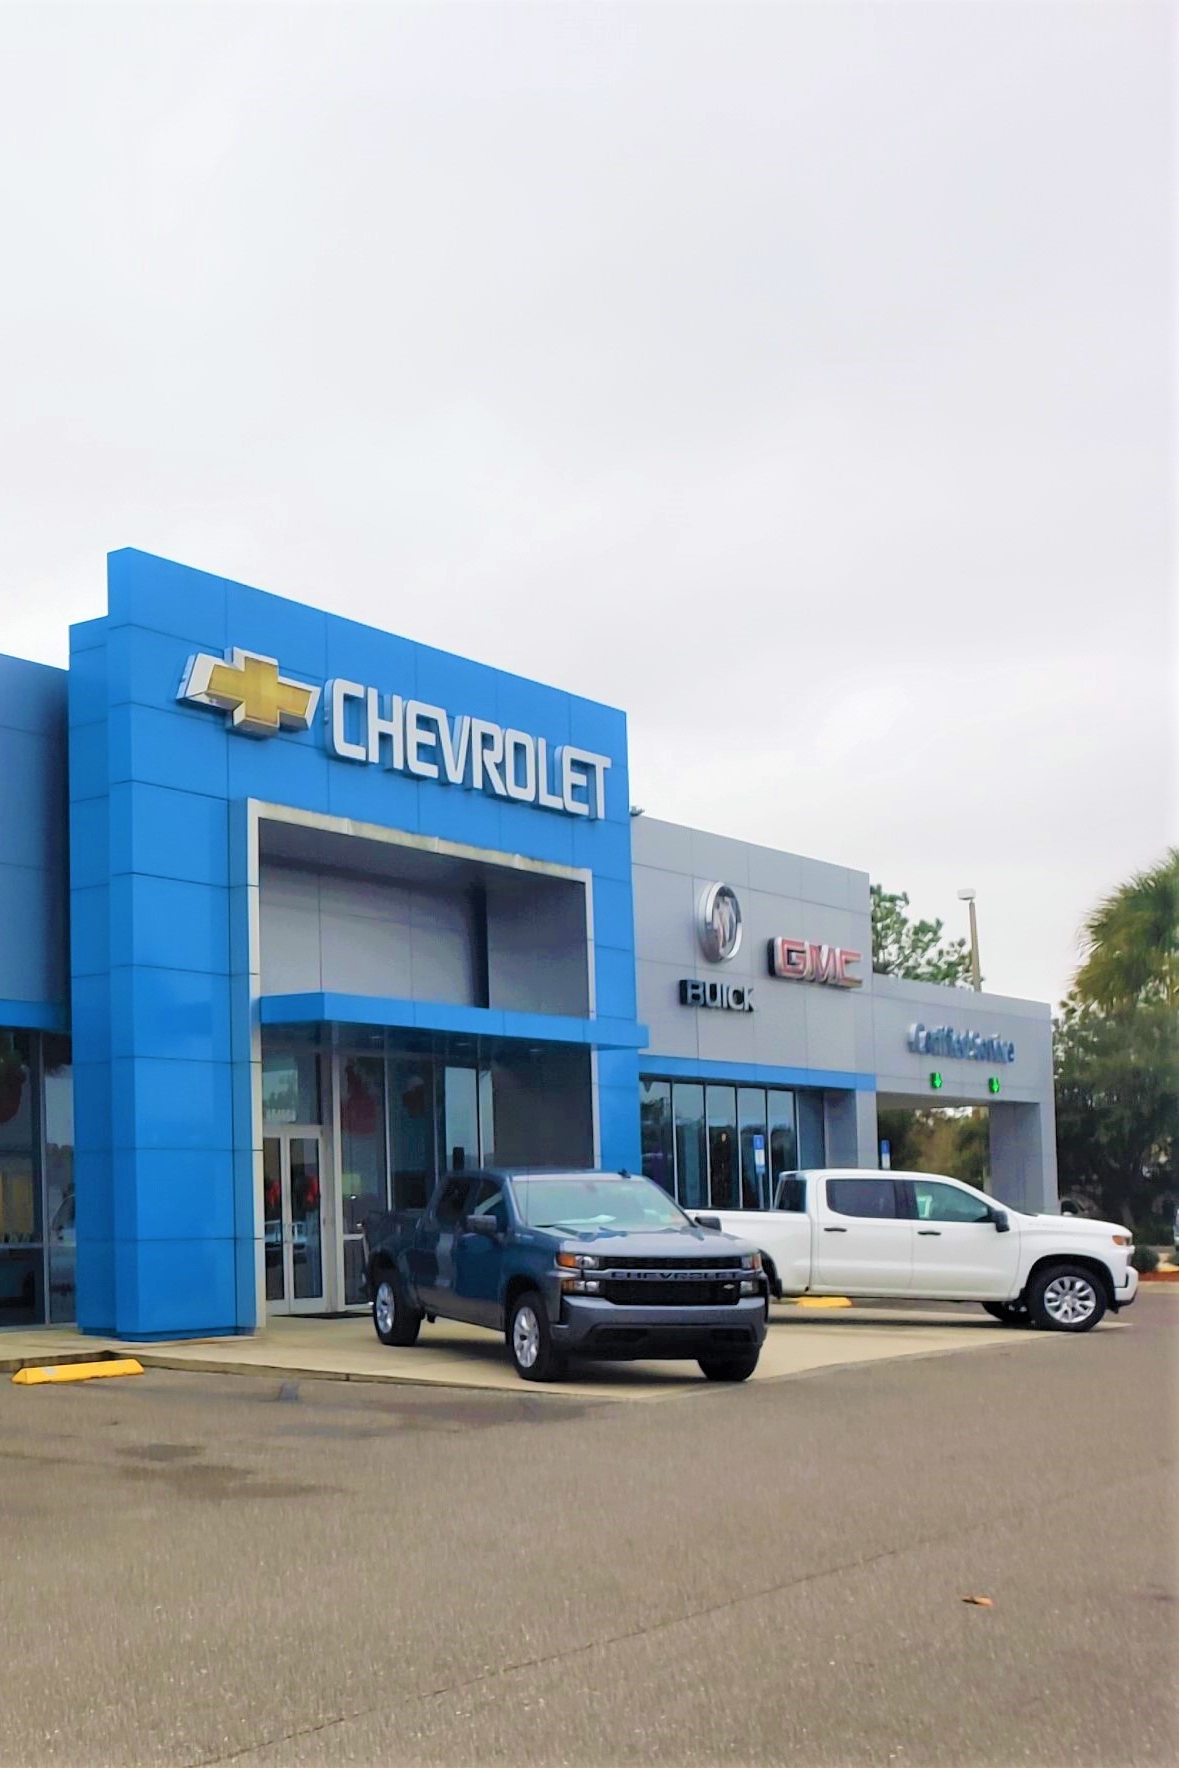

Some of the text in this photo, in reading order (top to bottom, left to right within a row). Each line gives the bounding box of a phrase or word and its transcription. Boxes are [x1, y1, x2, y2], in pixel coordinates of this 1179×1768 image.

[325, 678, 612, 820] CHEVROLET
[768, 937, 863, 989] GMC
[680, 979, 755, 1013] BUICK
